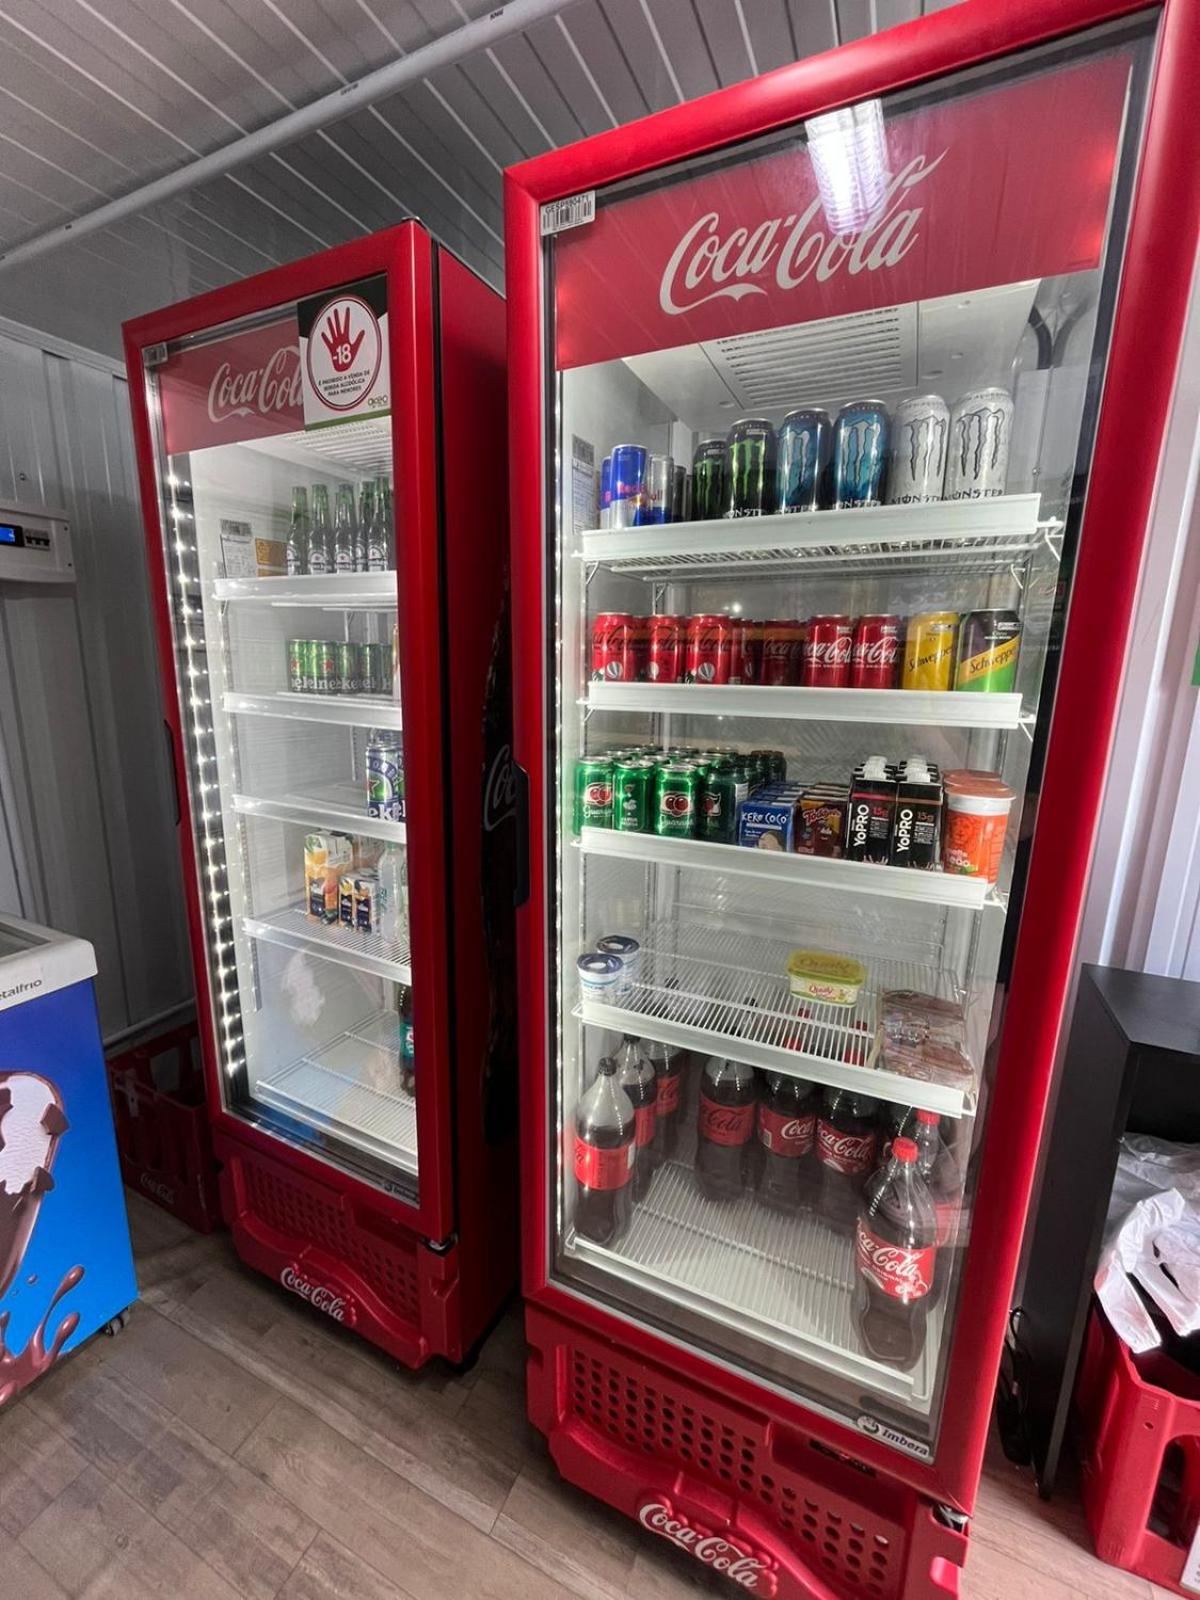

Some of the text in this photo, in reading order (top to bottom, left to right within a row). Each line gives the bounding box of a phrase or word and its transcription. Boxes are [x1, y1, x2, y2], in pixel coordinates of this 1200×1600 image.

[659, 148, 949, 315] Coca-Cola
[741, 811, 763, 823] KERO
[853, 804, 869, 847] YoPRO
[896, 809, 913, 853] YoPRO
[280, 1266, 346, 1321] Coca-Cola
[882, 1428, 928, 1455] Imbera
[639, 1503, 767, 1588] Coca-Cola
